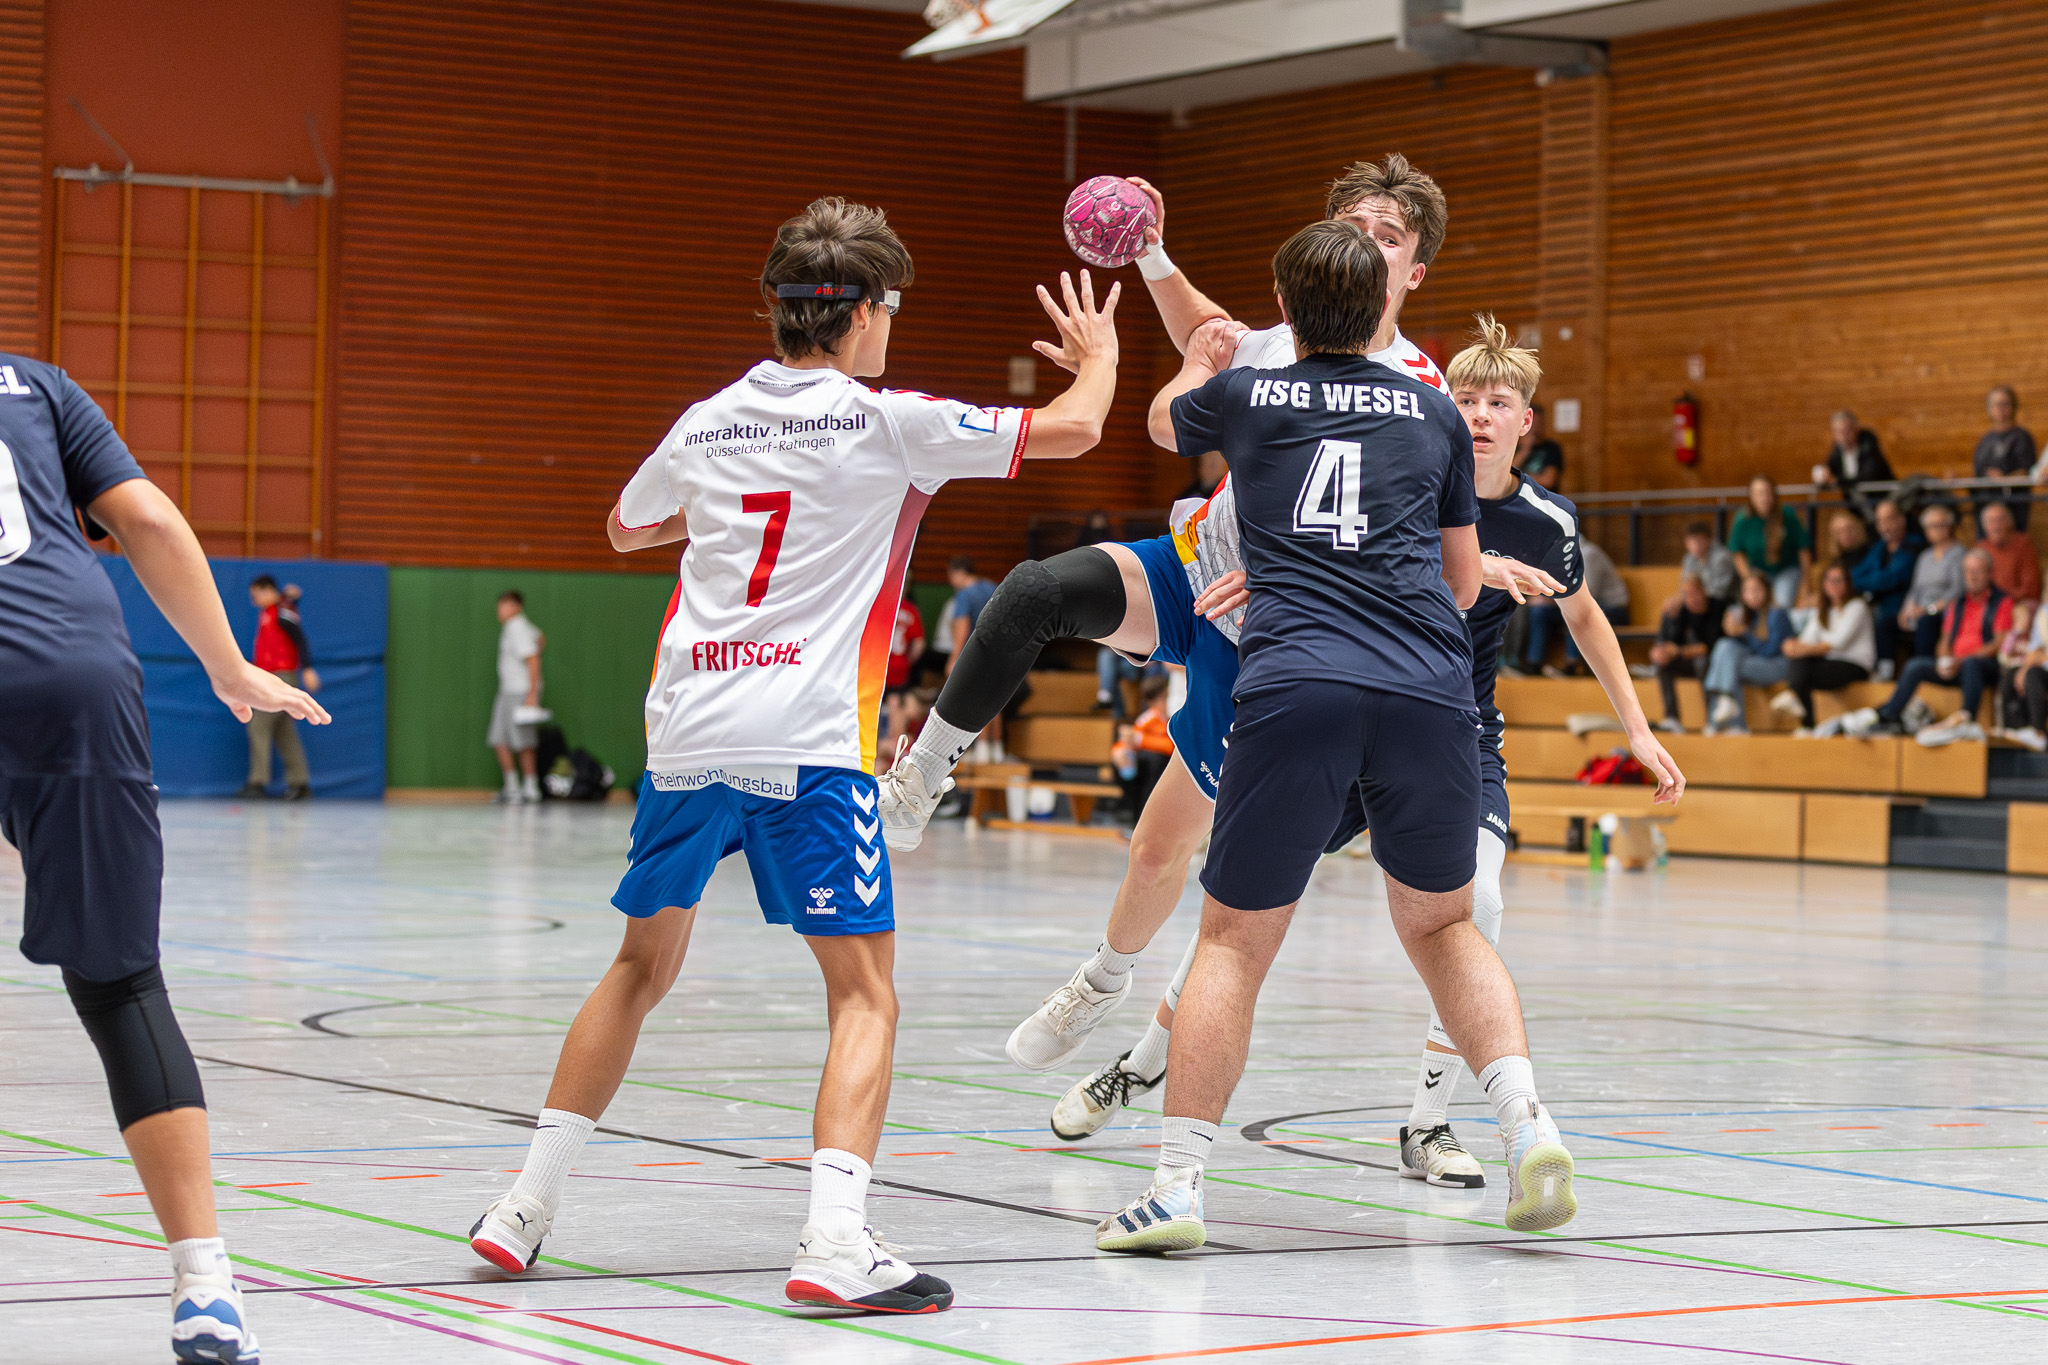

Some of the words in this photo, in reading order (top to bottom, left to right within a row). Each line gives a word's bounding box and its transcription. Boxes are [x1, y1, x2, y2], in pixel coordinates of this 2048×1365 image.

[1250, 379, 1311, 409] HSG
[1321, 382, 1425, 420] WESEL
[706, 437, 835, 458] Düsseldorf-Ratingen
[1293, 439, 1369, 551] 4
[741, 490, 792, 607] 7
[692, 637, 807, 671] FRITSCHE
[1486, 812, 1507, 833] JAKO
[806, 905, 837, 915] hummel
